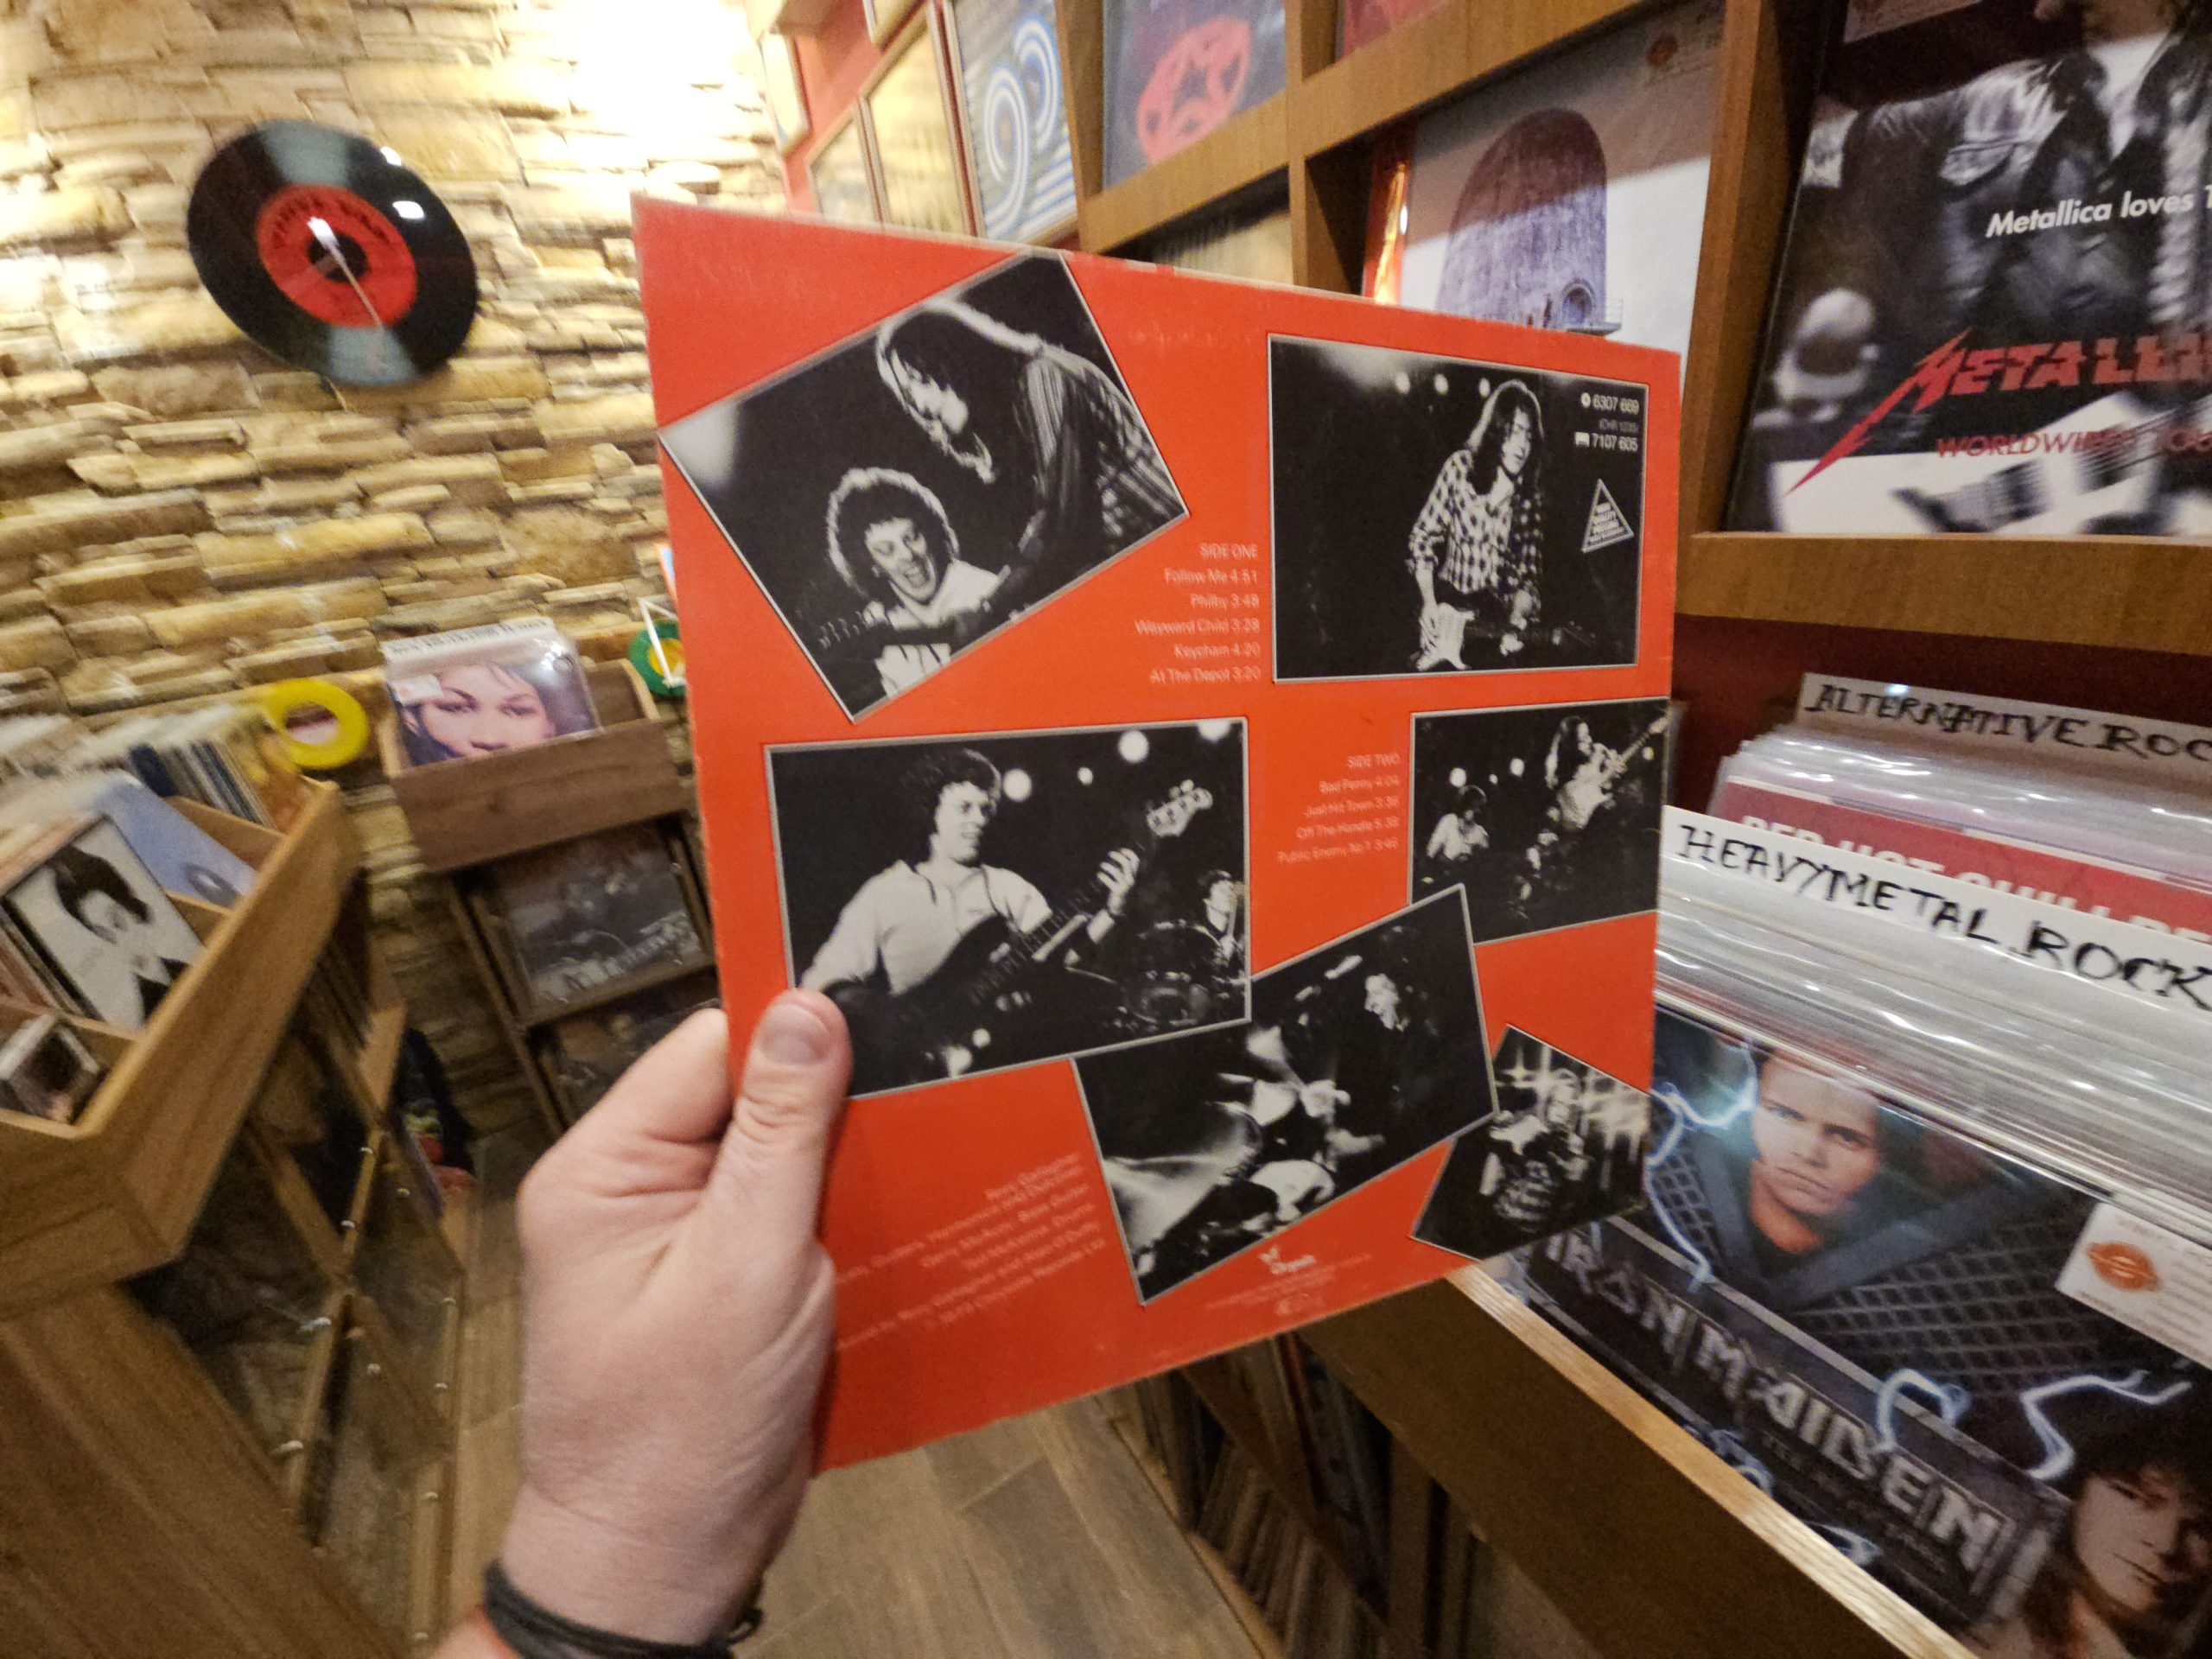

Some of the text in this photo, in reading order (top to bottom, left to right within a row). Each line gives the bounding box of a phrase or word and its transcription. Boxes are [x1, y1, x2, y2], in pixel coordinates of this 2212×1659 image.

[1985, 198, 2113, 238] Metallica
[2119, 190, 2196, 219] loves
[1592, 392, 1618, 411] 6307
[1783, 327, 2212, 496] METALLI
[1592, 432, 1638, 453] 7107 605
[1199, 543, 1258, 560] SIDE ONE
[1164, 568, 1205, 585] Follow
[1208, 569, 1228, 585] Me
[1806, 684, 2088, 747] ALTERNATIVE
[2013, 920, 2212, 1009] ROCK
[1694, 1323, 2015, 1593] MAIDEN
